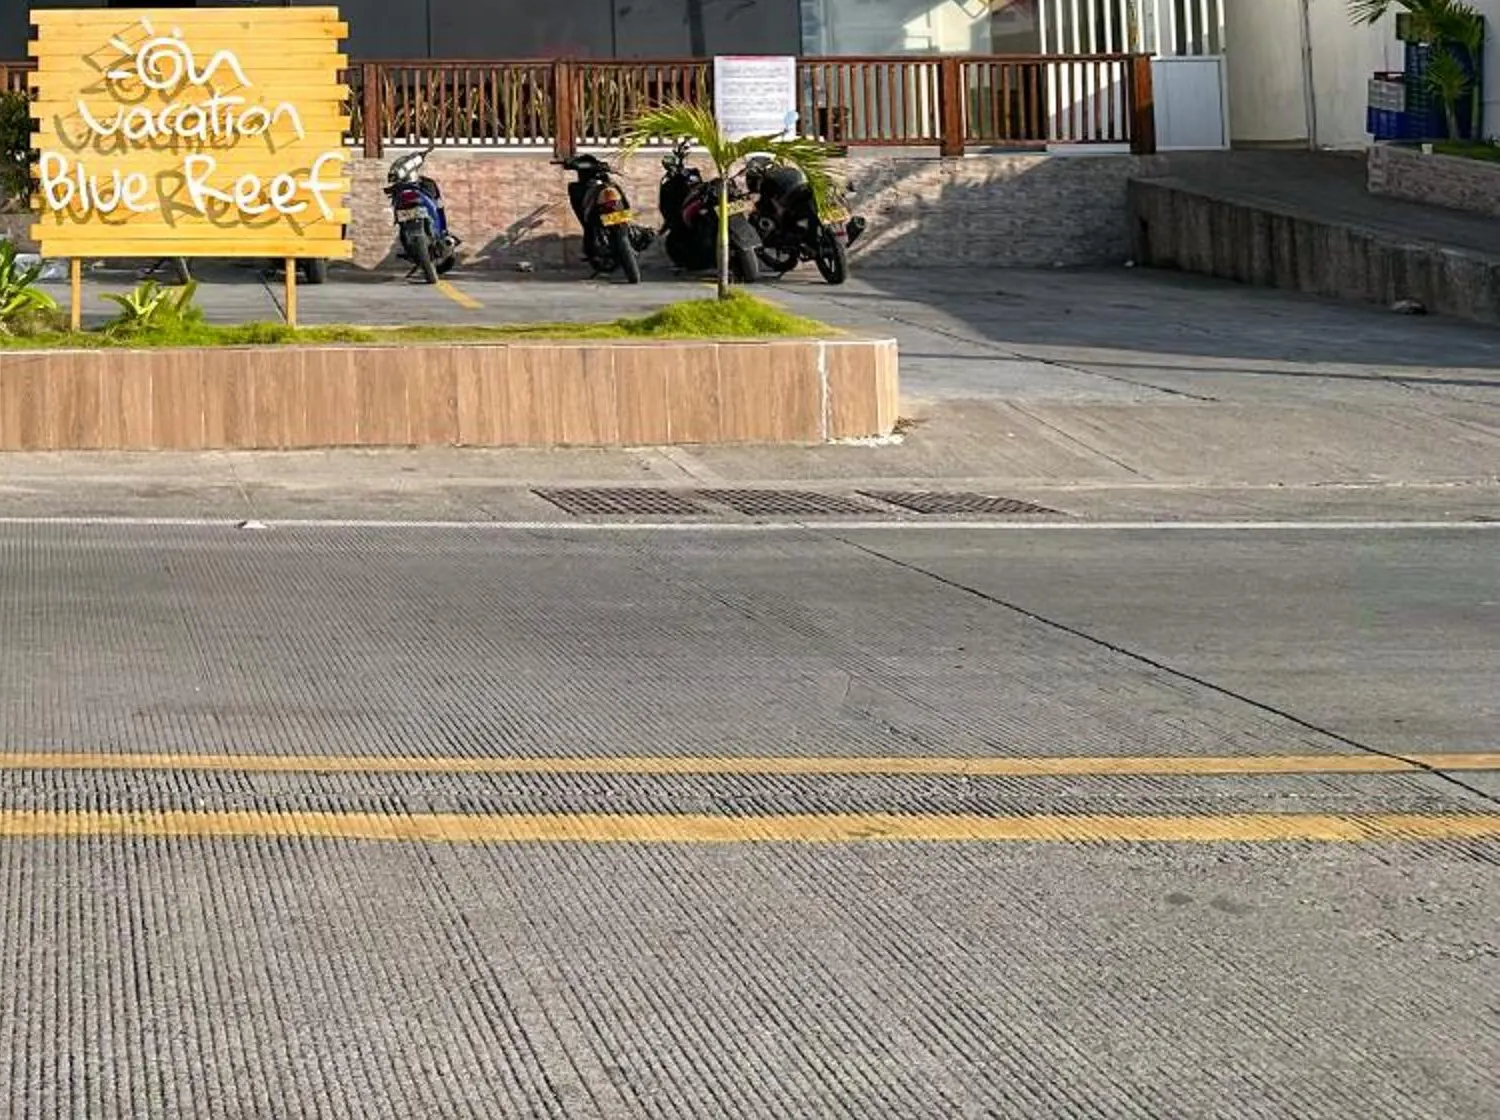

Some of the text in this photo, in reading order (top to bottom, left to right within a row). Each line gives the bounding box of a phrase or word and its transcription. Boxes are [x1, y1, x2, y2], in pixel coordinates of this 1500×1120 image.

[136, 36, 252, 90] On
[40, 151, 345, 221] Blue Reef
